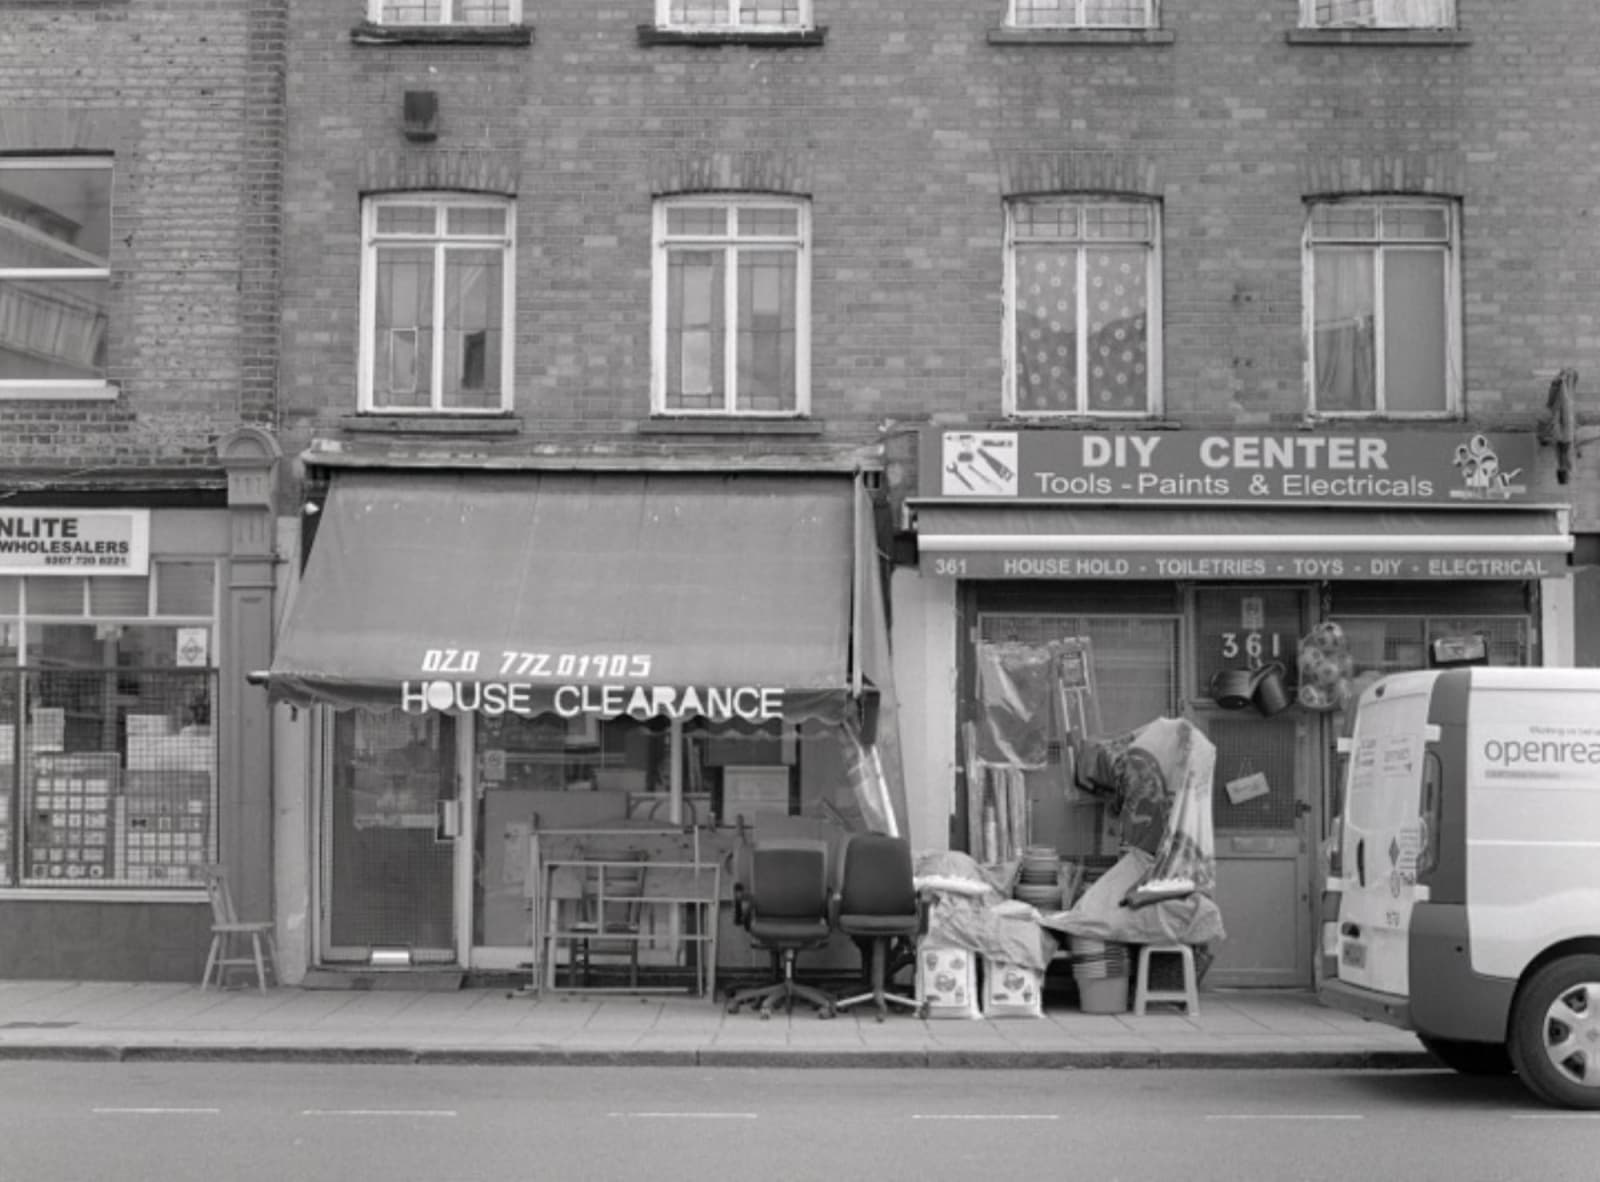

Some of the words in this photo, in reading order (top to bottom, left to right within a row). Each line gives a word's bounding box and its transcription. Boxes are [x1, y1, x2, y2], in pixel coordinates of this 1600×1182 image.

[1082, 435, 1161, 468] DIY
[1199, 435, 1389, 469] CENTER
[1034, 472, 1113, 495] Tools
[1138, 473, 1230, 496] Paints
[1248, 474, 1270, 496] &
[1283, 474, 1433, 497] Electricals
[0, 517, 78, 538] NLITE
[0, 541, 129, 553] WHOLESALERS
[935, 559, 967, 575] 361
[1004, 558, 1071, 575] HOUSE
[1076, 558, 1129, 575] HOLD
[1156, 558, 1266, 576] TOILETRIES
[1293, 558, 1344, 576] TOYS
[1370, 558, 1402, 576] DIY
[1429, 558, 1548, 576] ELECTRICAL
[1221, 632, 1280, 658] 361
[402, 680, 531, 714] HOUSE
[554, 685, 785, 718] CLEARANCE
